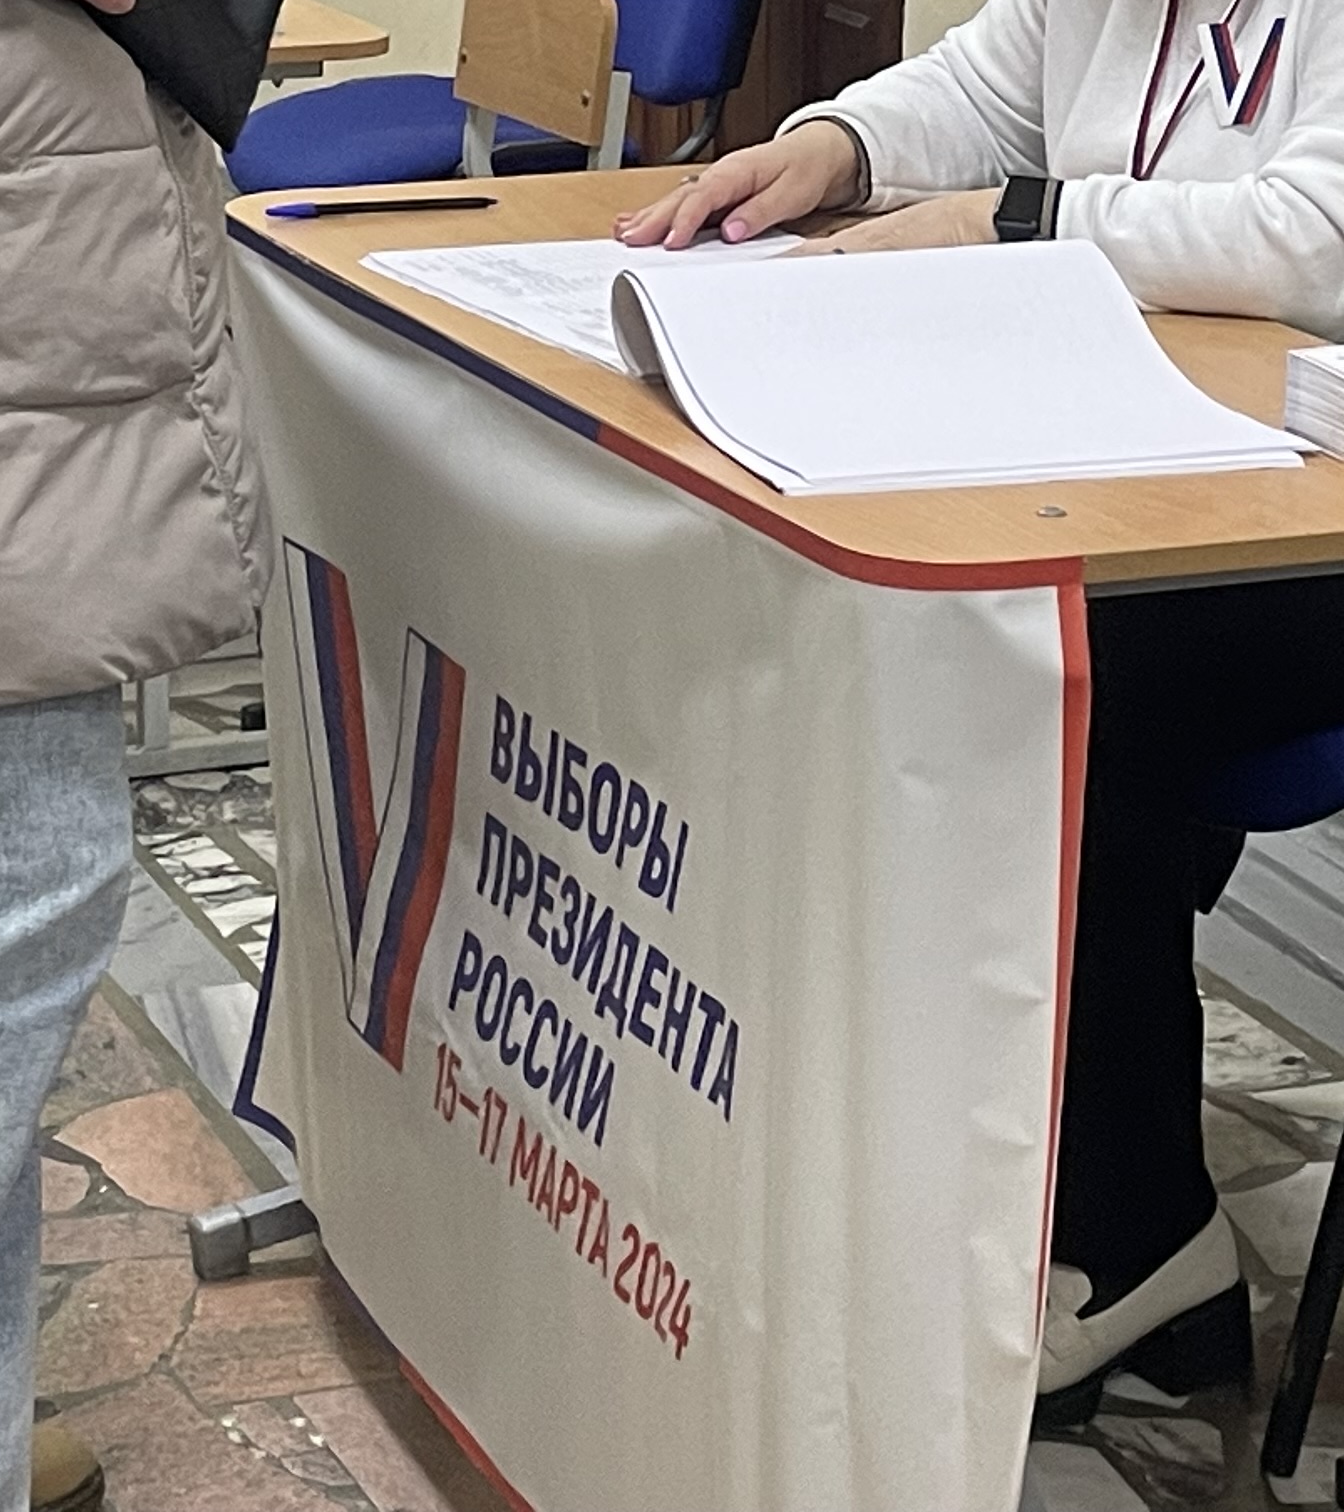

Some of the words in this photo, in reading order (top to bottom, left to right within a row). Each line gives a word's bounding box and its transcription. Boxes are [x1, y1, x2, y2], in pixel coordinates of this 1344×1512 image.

[489, 693, 689, 914] ВЫБОРЫ
[448, 929, 616, 1147] РОССИИ
[476, 811, 742, 1123] ПРЕЗИДЕНТА
[510, 1116, 609, 1277] МАРТА
[614, 1223, 691, 1360] 2024
